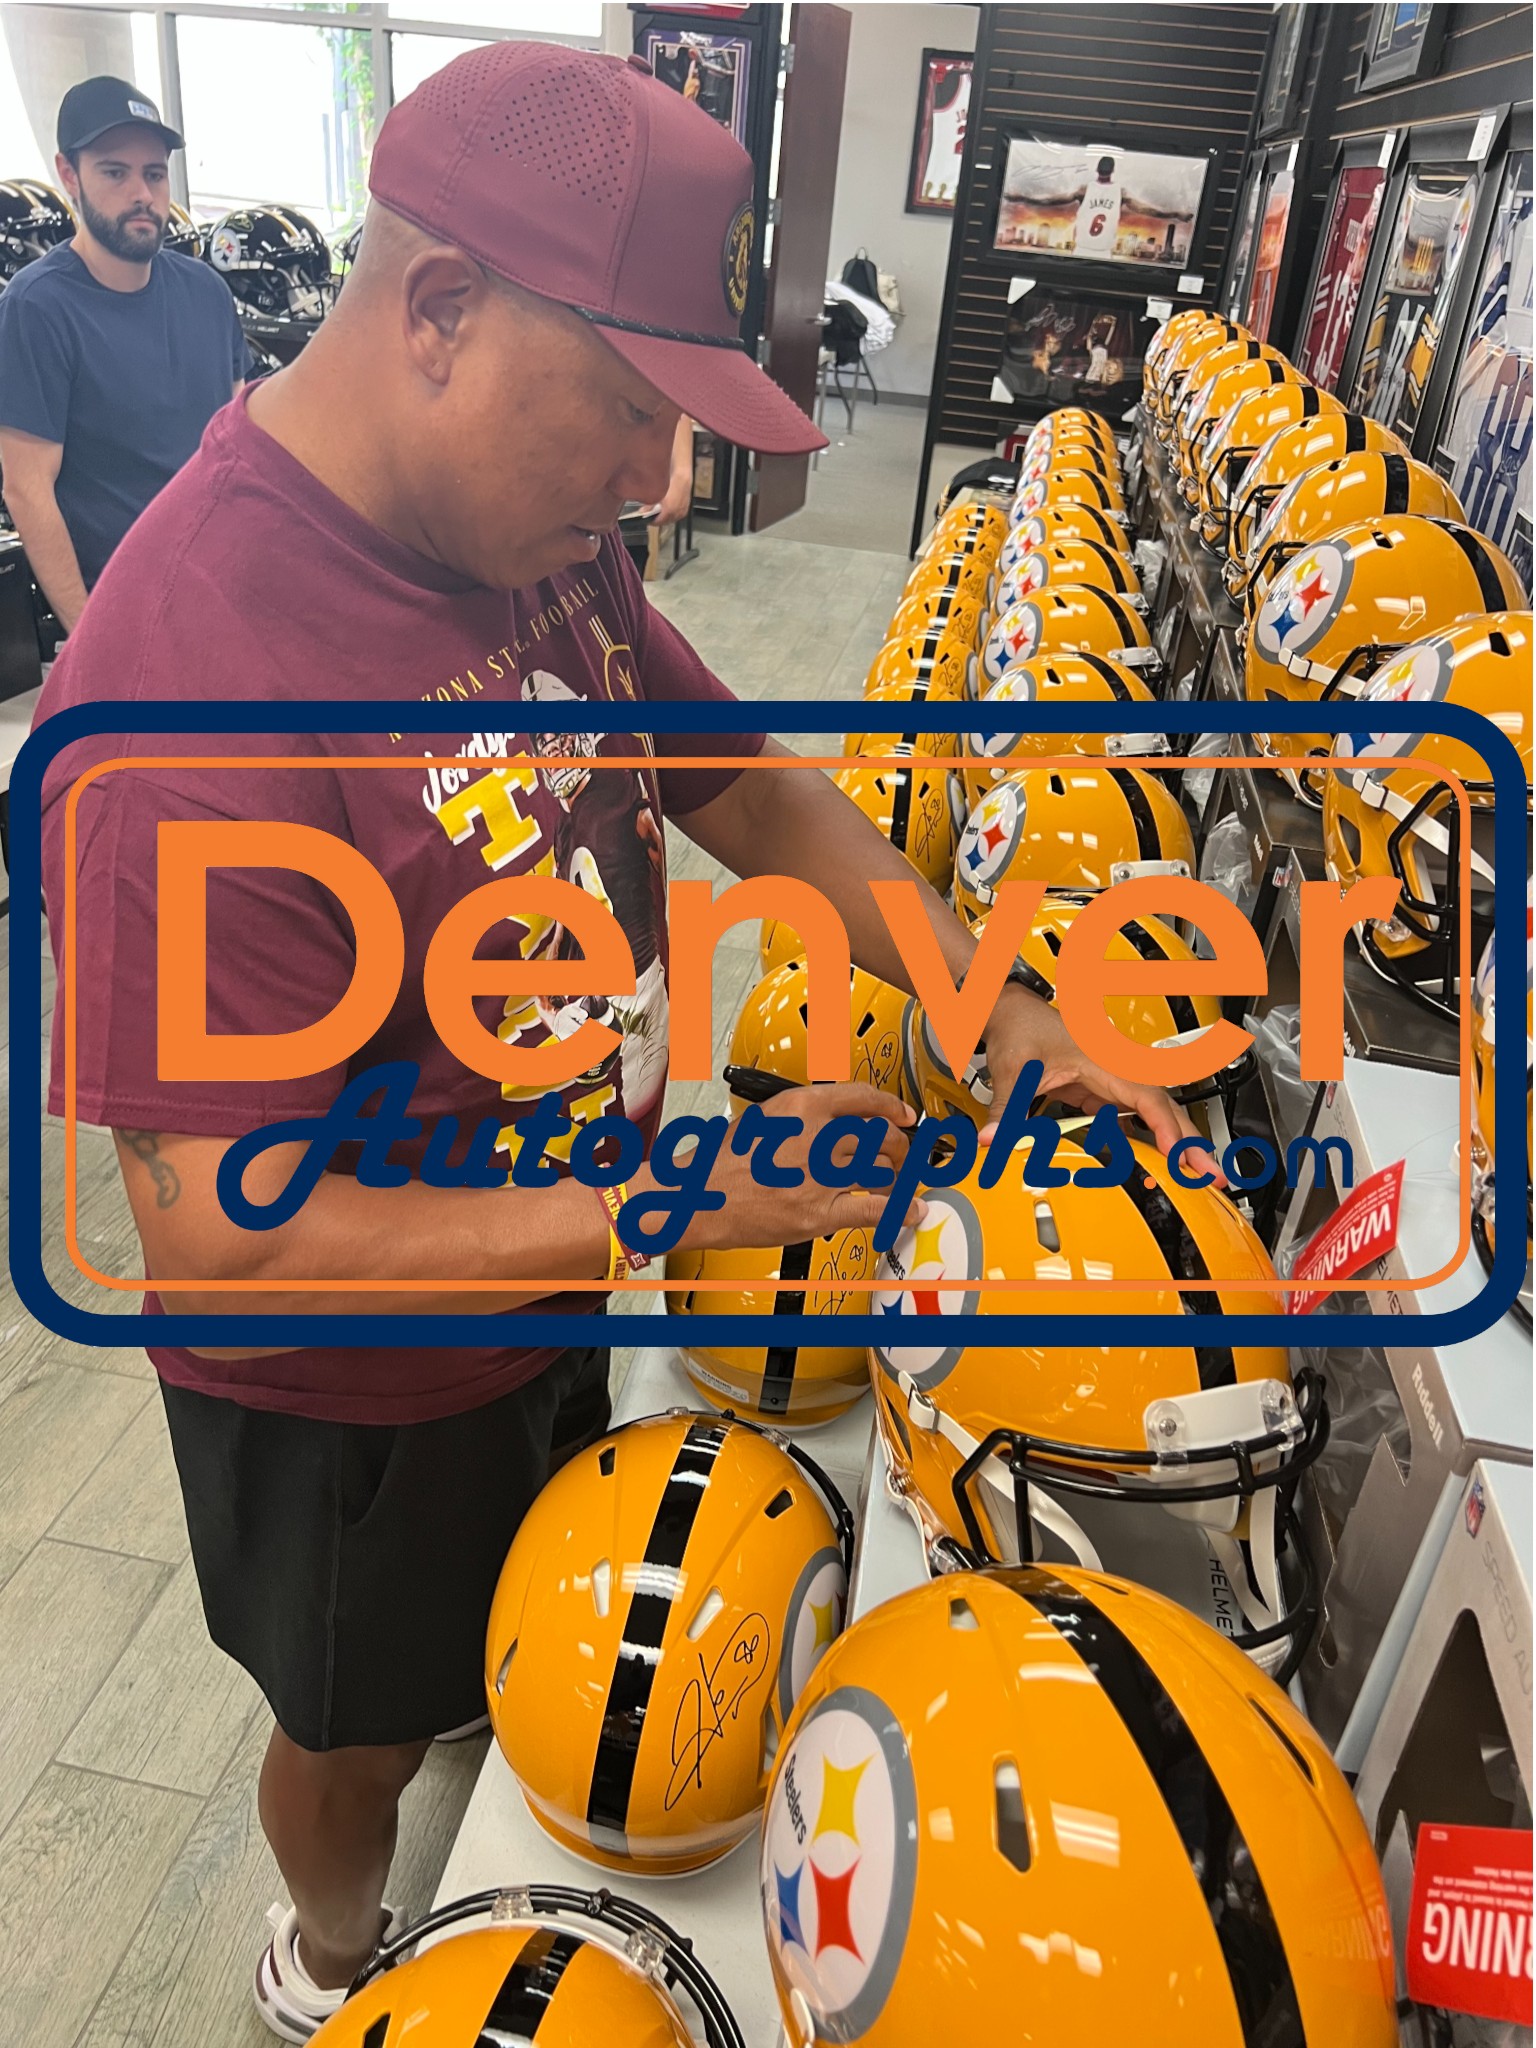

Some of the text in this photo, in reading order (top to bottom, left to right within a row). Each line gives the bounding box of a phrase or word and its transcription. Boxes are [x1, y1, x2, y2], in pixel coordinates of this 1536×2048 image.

[1089, 198, 1115, 210] JAMES
[1089, 213, 1107, 237] 6
[1412, 1362, 1445, 1450] Riddell
[1481, 1540, 1518, 1649] SPEED
[783, 1752, 808, 1846] Steelers
